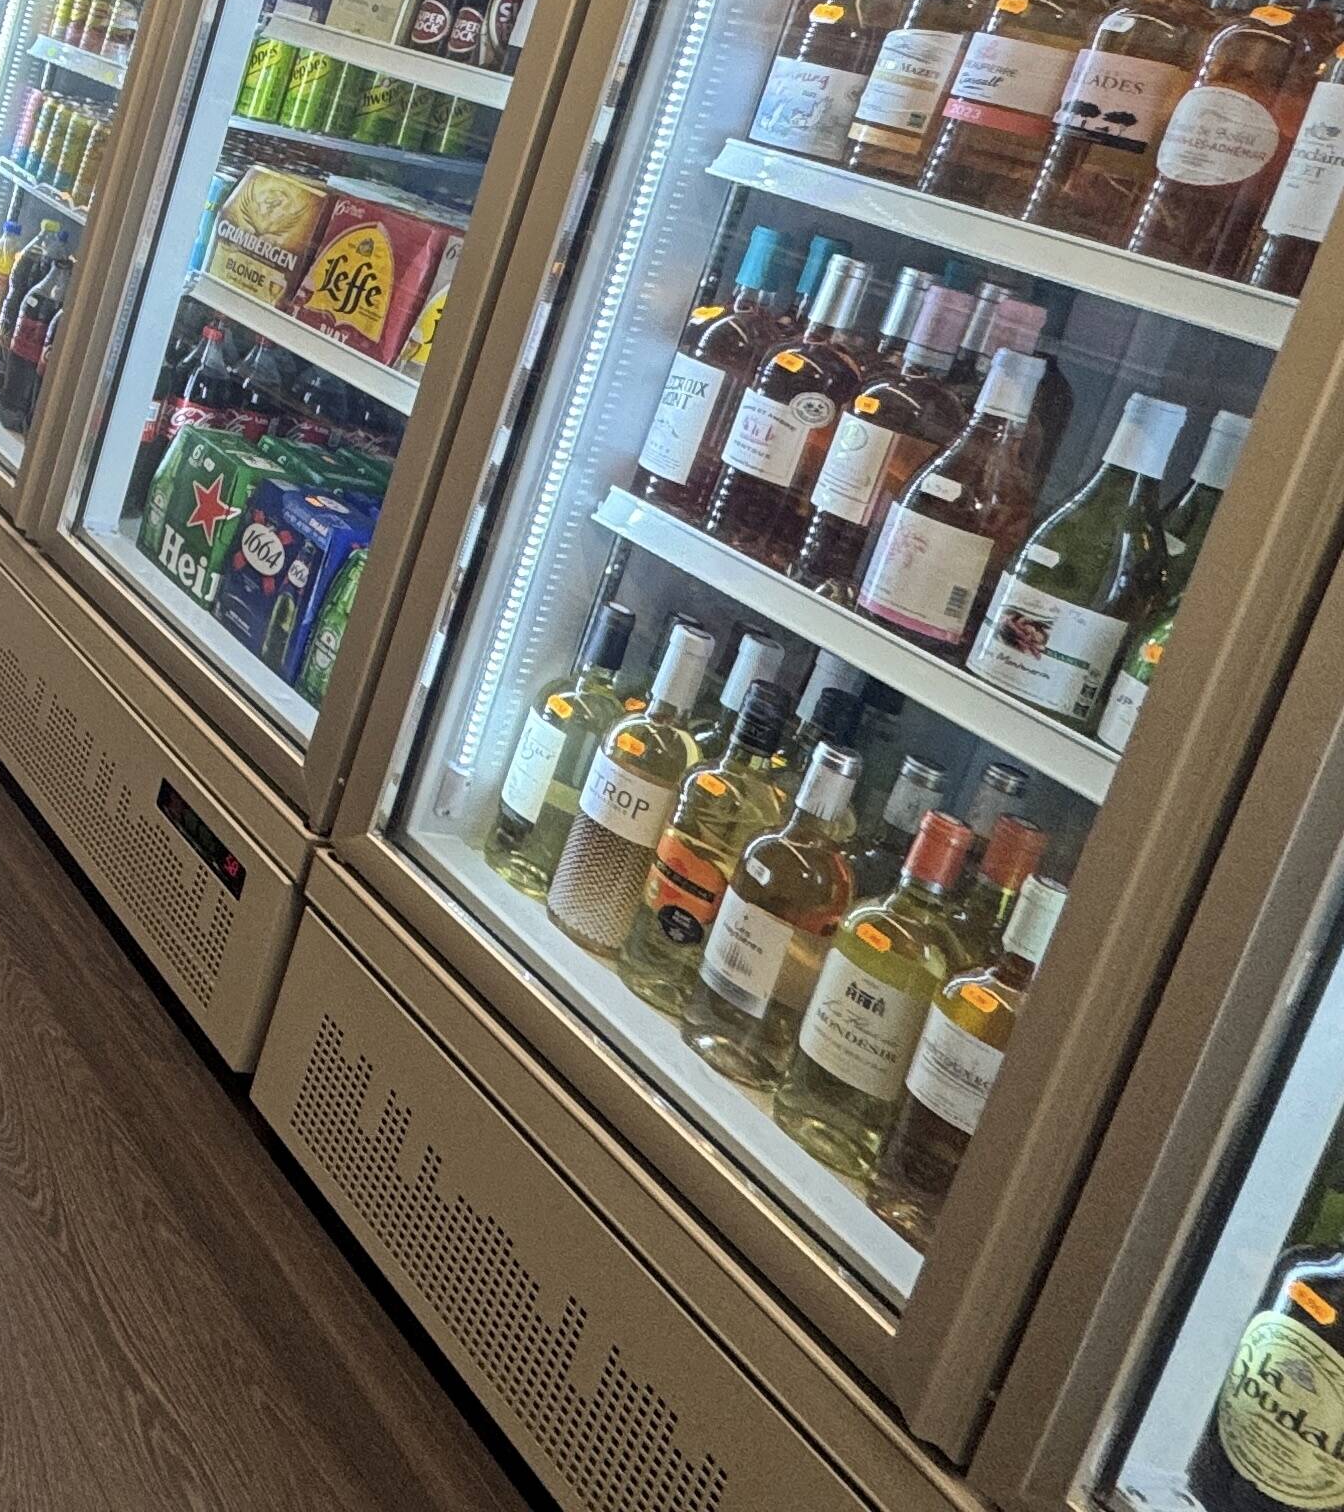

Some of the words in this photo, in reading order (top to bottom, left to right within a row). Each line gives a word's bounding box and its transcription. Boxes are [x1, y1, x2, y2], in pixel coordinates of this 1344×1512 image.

[1090, 73, 1144, 95] ADES
[950, 103, 982, 120] 2023
[218, 219, 298, 271] GRIMBERGEN
[225, 257, 266, 284] BLONDE
[318, 254, 381, 315] Leffe
[243, 529, 282, 569] 1664
[590, 773, 650, 820] TROP
